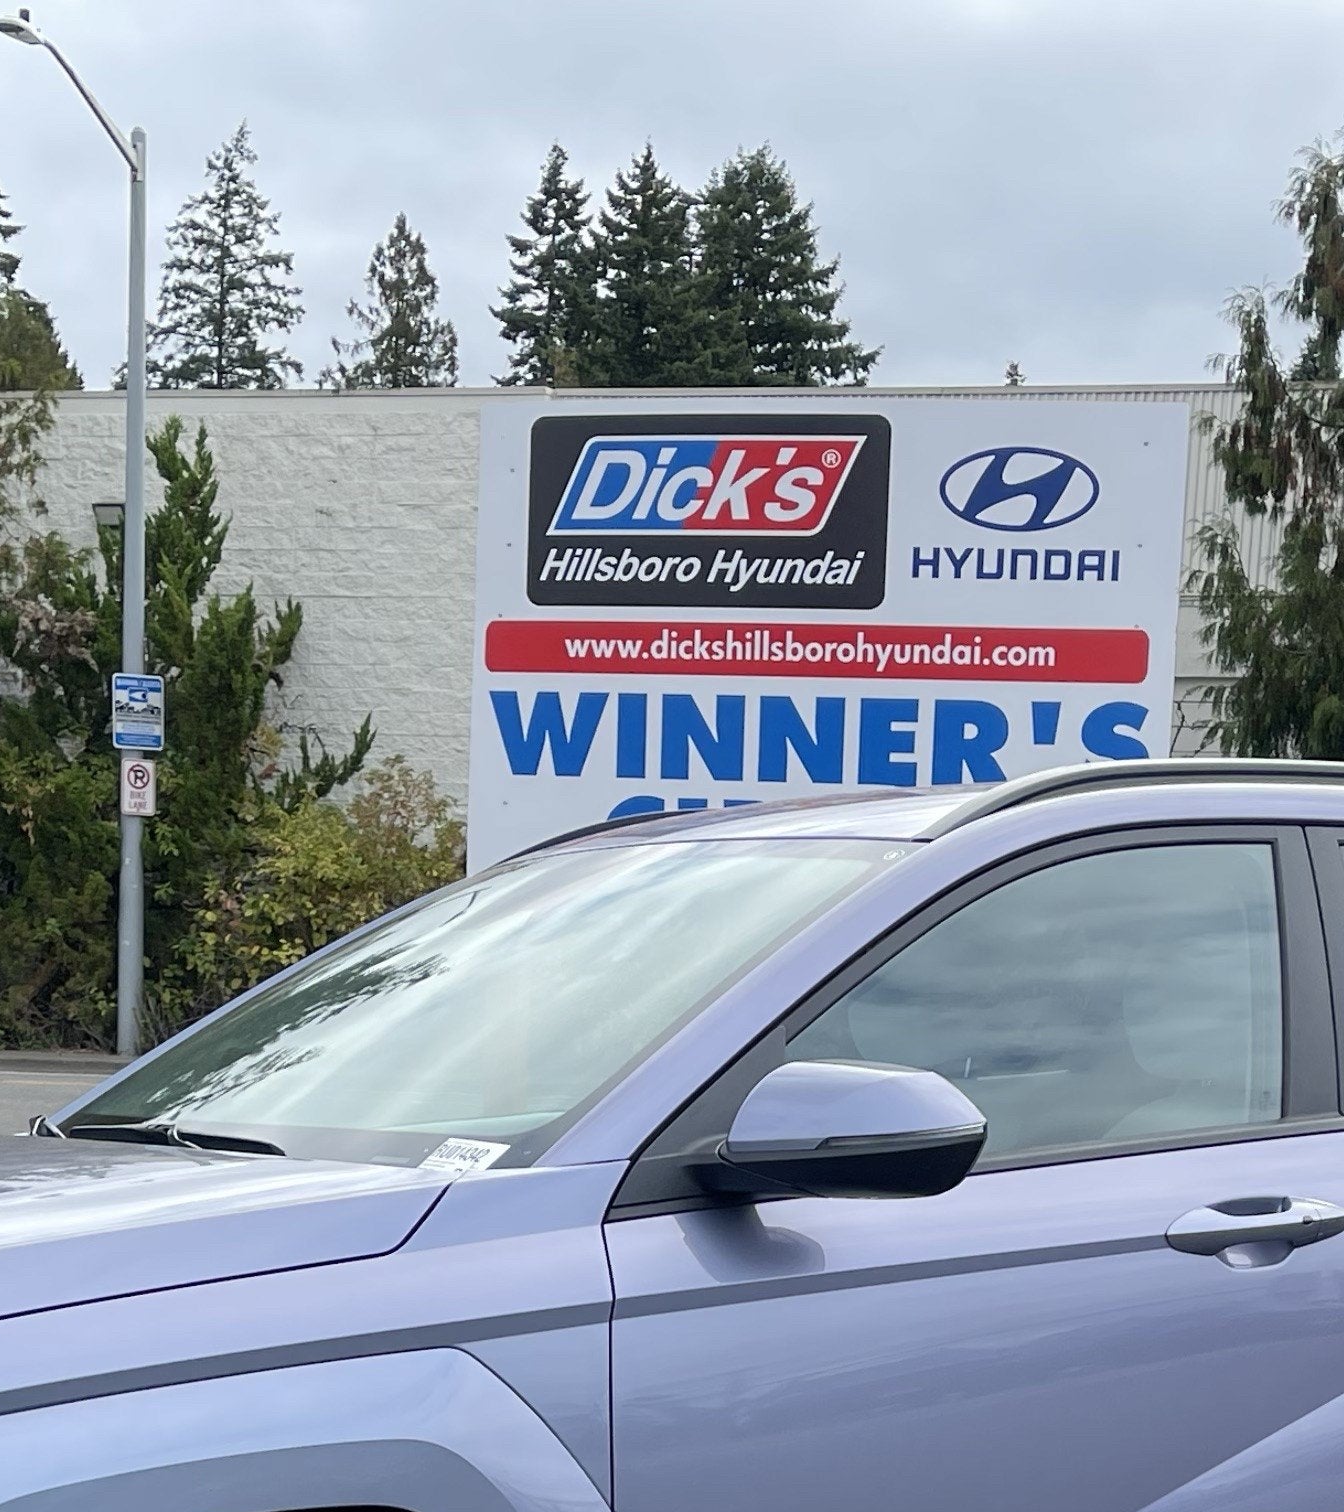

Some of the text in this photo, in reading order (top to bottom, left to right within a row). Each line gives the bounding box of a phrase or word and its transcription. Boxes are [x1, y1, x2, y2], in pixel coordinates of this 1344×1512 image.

[540, 548, 865, 592] Hillsboro Hyundai
[912, 546, 1120, 582] HYUNDAI
[564, 629, 1056, 672] www.dickshillsborohyundai.com
[491, 690, 1150, 786] WINNER'S
